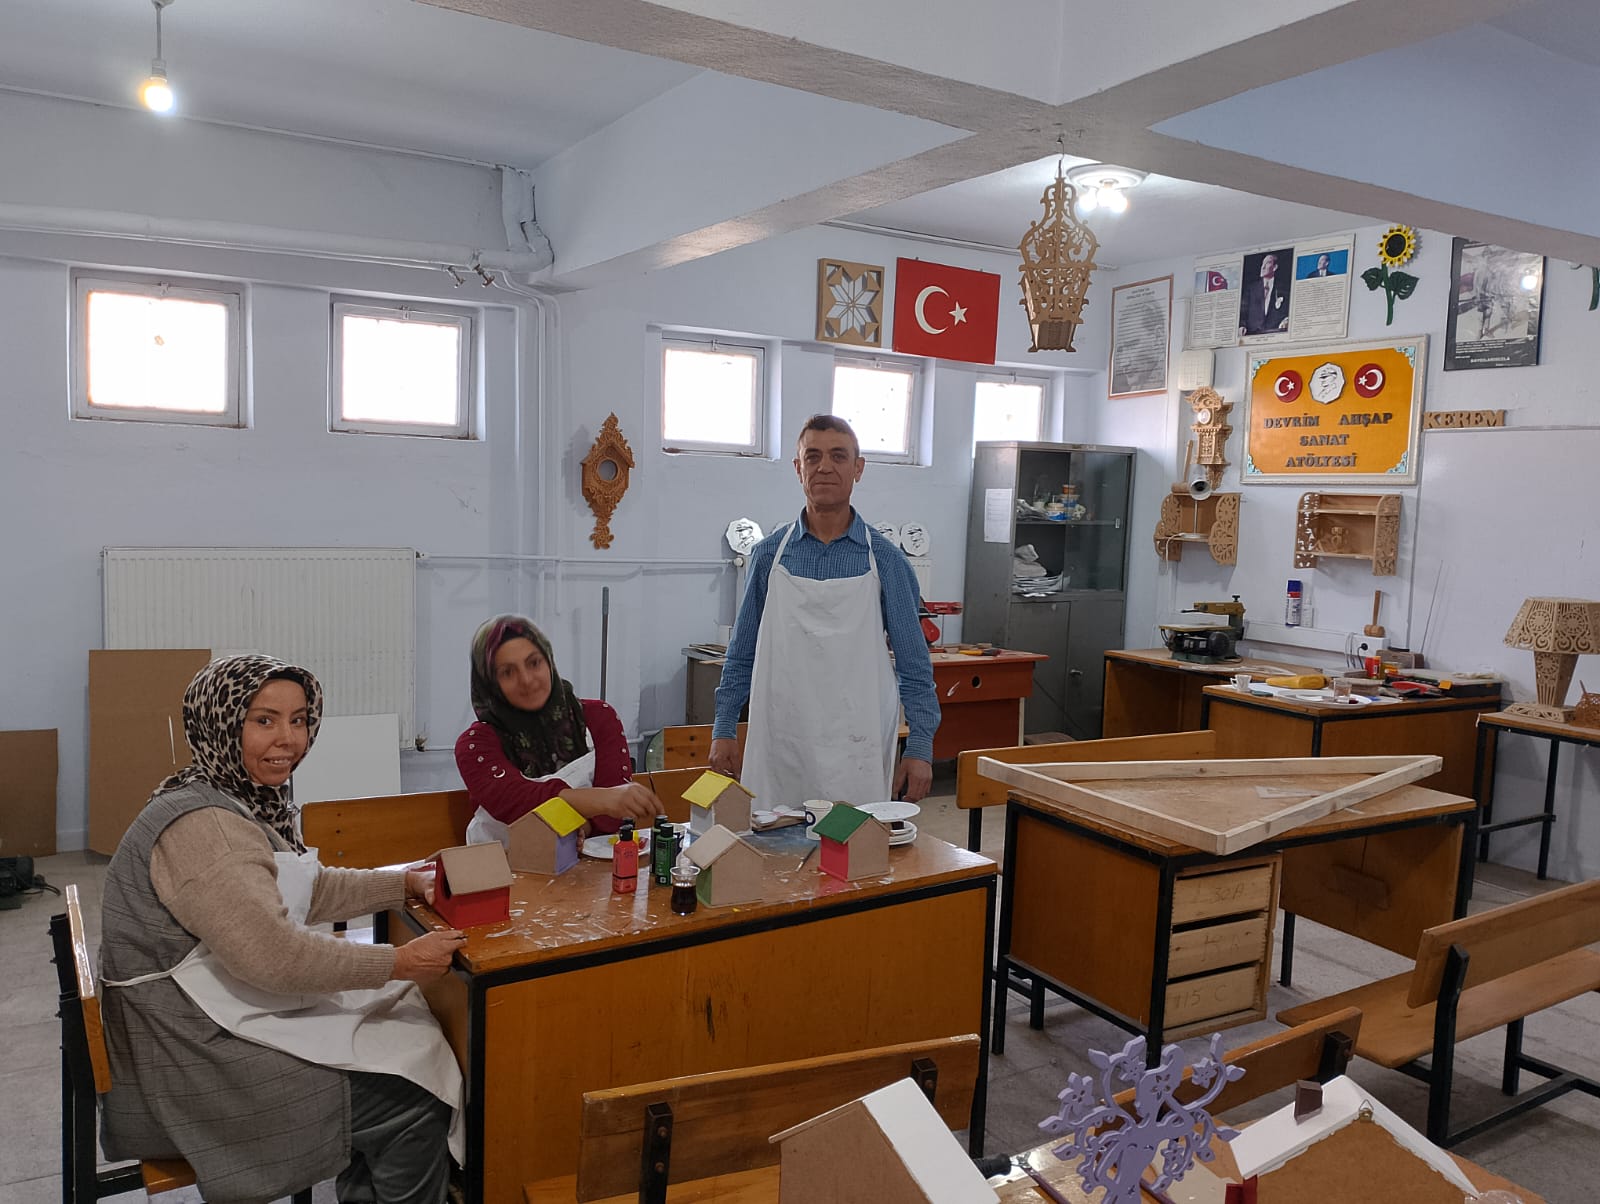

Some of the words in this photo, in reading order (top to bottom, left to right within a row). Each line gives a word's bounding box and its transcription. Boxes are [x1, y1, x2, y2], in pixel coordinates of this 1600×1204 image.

[1264, 413, 1320, 428] DEVRİM
[1338, 412, 1393, 427] AHŞAP
[1423, 409, 1505, 429] KEREM
[1299, 434, 1350, 446] SANAT
[1285, 452, 1358, 468] ATÖLYESİ
